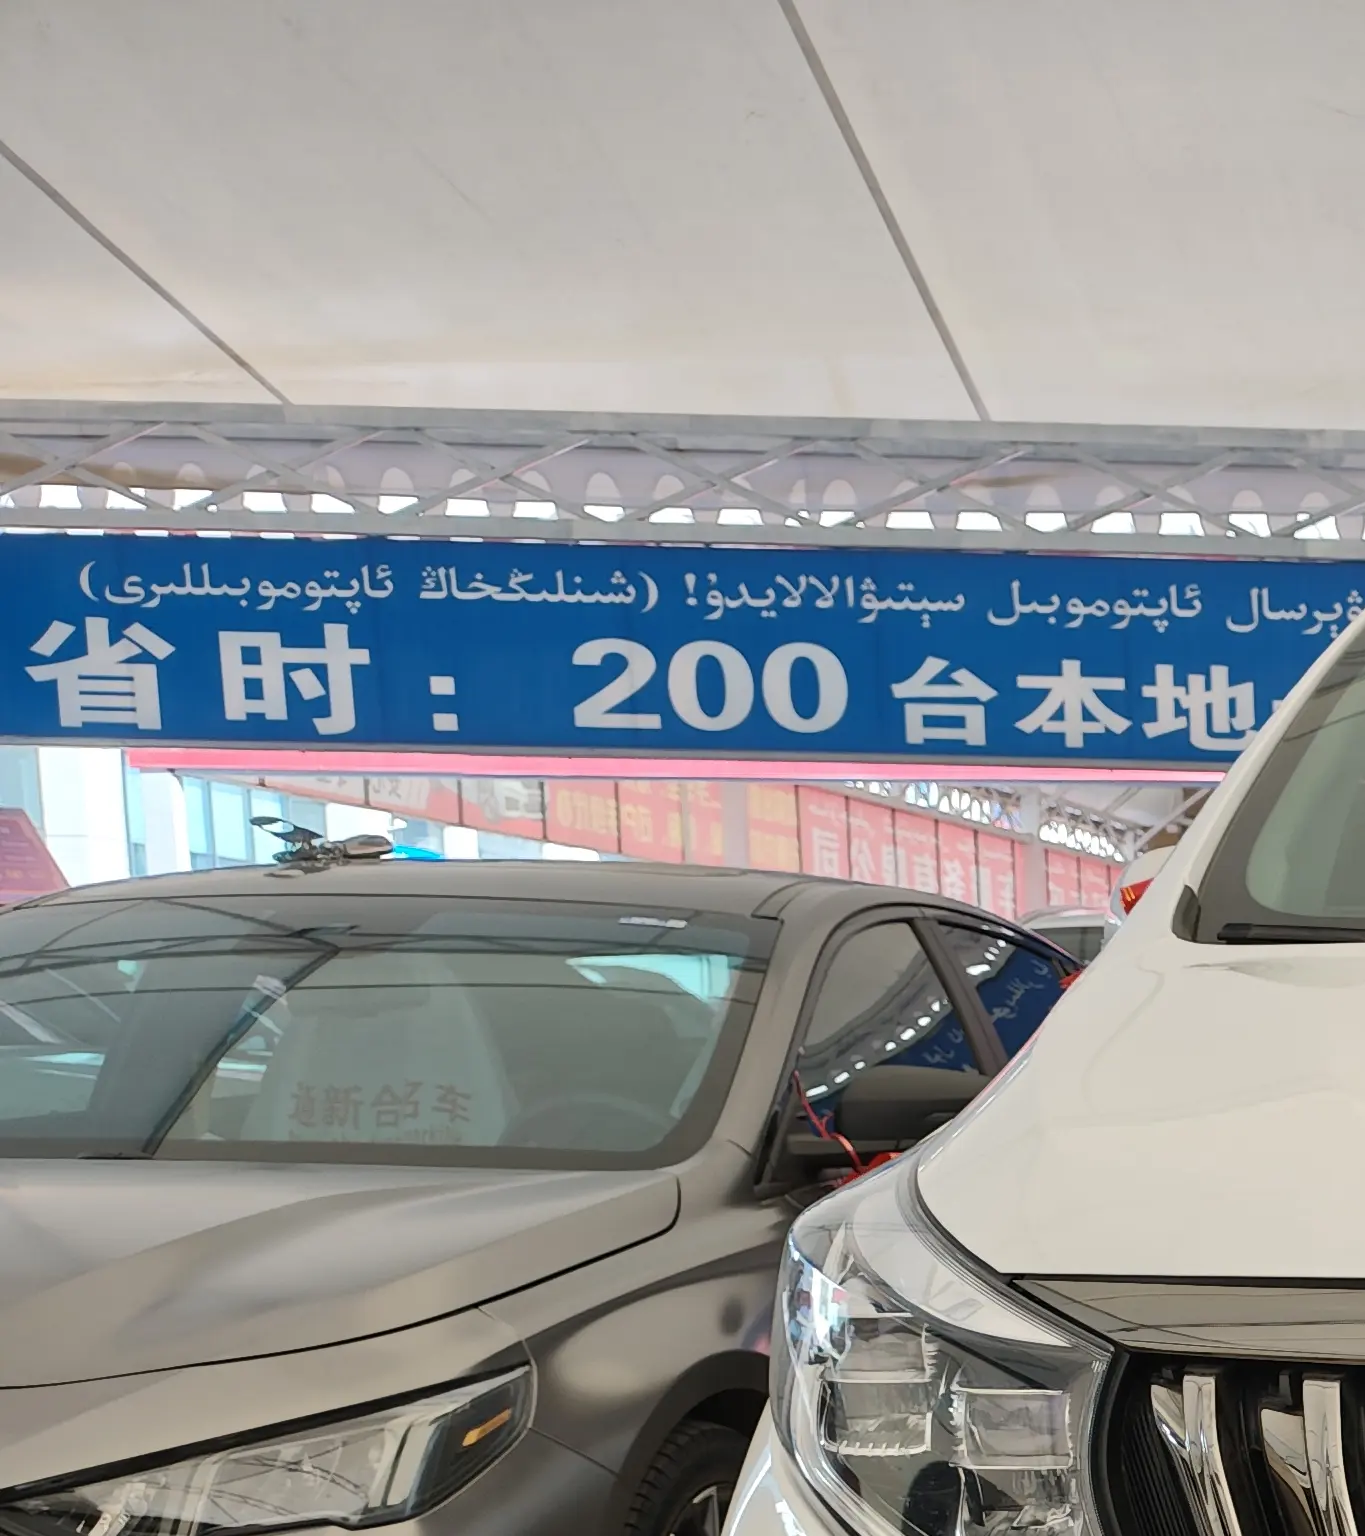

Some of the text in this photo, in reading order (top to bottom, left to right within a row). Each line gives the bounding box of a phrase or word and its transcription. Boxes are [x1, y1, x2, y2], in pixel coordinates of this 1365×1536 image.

[572, 637, 849, 733] 200
[889, 655, 1284, 752] 台本地
